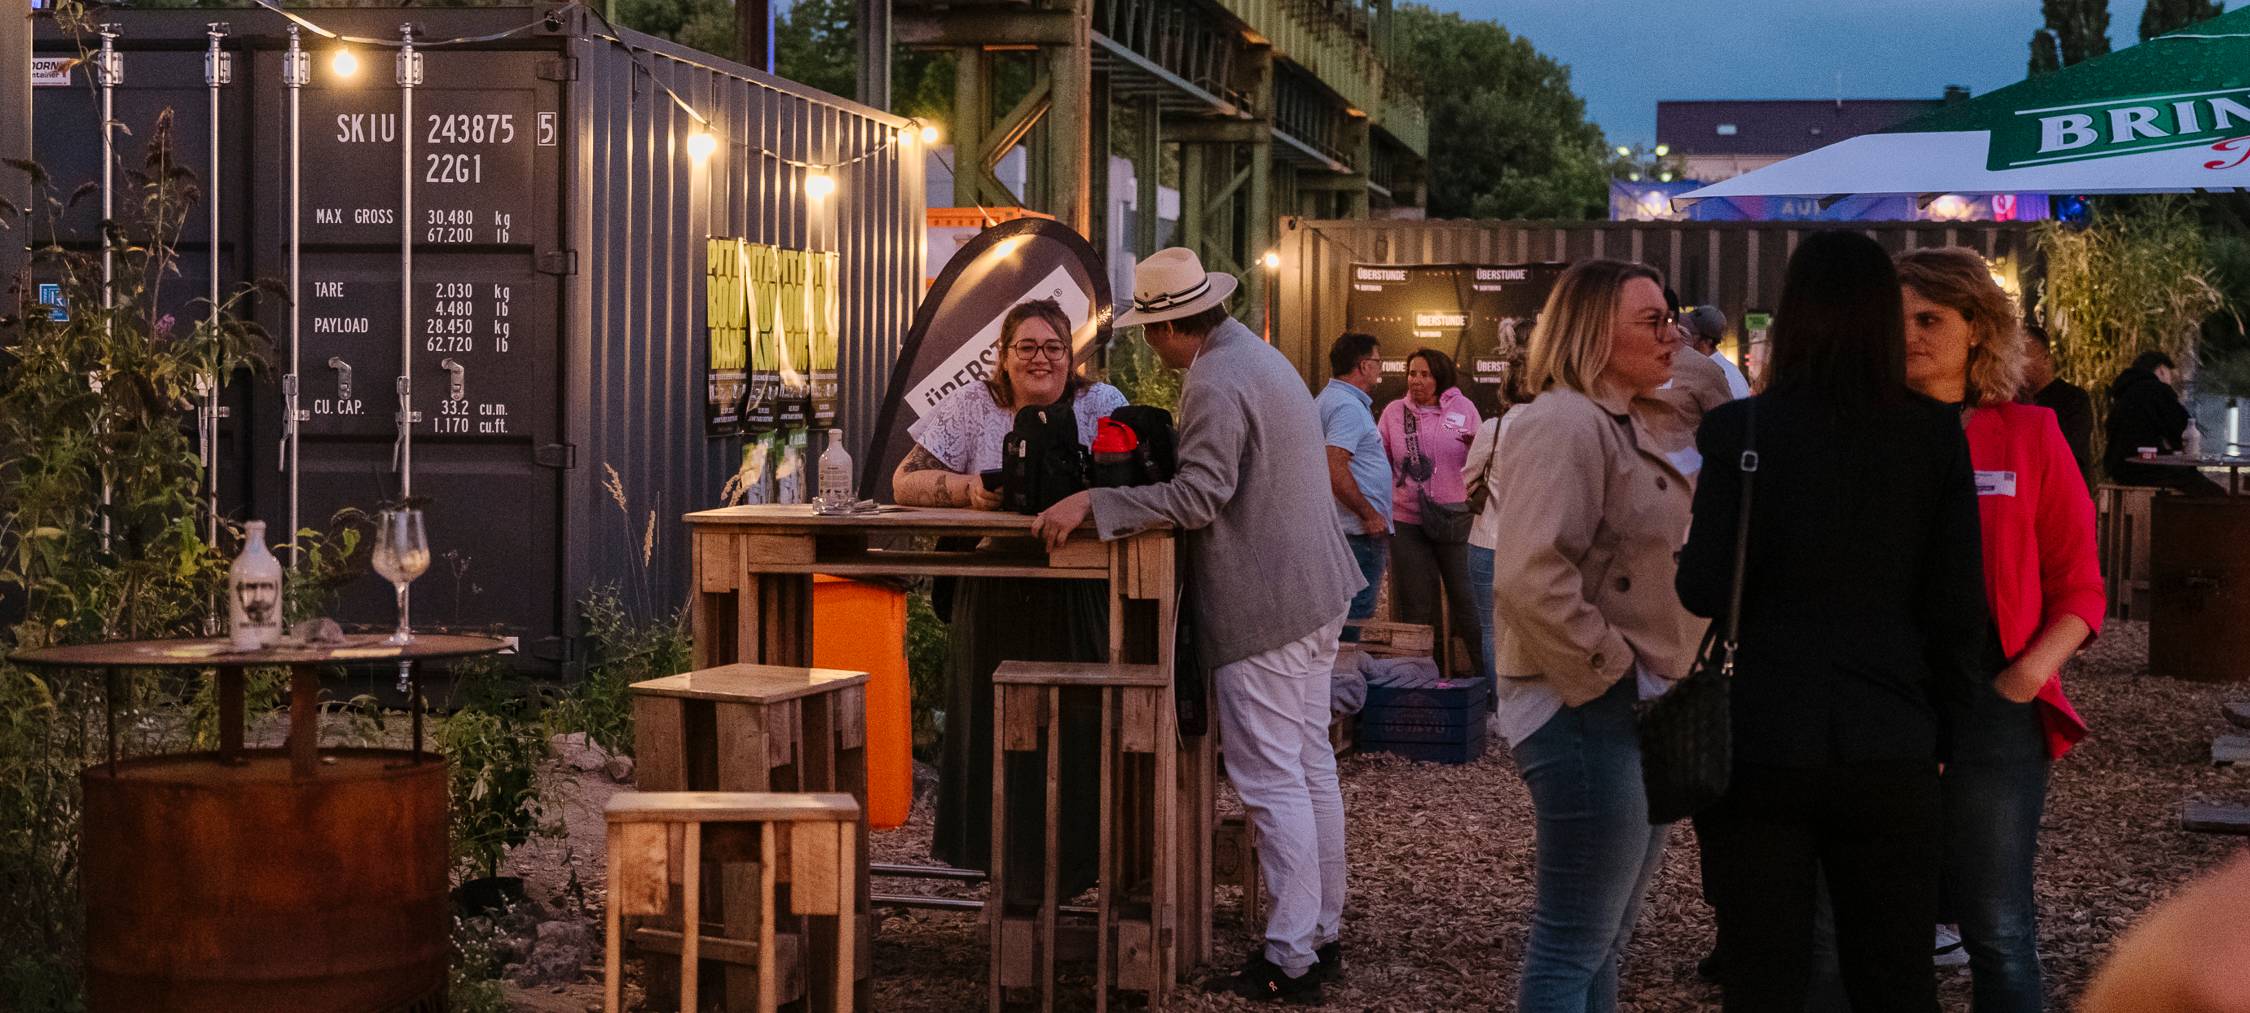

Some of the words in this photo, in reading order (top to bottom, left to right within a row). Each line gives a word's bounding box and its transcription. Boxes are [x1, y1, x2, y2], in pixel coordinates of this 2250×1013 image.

[337, 113, 395, 143] SKIU
[427, 114, 515, 144] 243875
[540, 114, 554, 144] 5
[2037, 94, 2250, 154] BRIN
[425, 154, 481, 184] 22G1
[316, 208, 343, 224] MAX
[354, 208, 394, 224] GROSS
[427, 209, 473, 225] 30.480
[495, 210, 511, 230] kg
[427, 227, 473, 243] 67.200
[496, 229, 509, 244] lb
[314, 282, 344, 298] TARE
[435, 283, 473, 298] 2.030
[494, 284, 510, 302] kg
[435, 301, 473, 316] 4.480
[496, 302, 509, 317] lb
[314, 318, 369, 333] PAYLOAD
[427, 319, 473, 334] 28.450
[494, 320, 510, 339] kg
[427, 337, 473, 352] 62.720
[496, 337, 509, 353] lb
[314, 400, 333, 415] CU.
[337, 400, 365, 415] CAP.
[441, 400, 469, 416] 33.2
[479, 403, 508, 416] cu.m.
[433, 418, 469, 433] 1.170
[479, 418, 508, 434] cu.ft.
